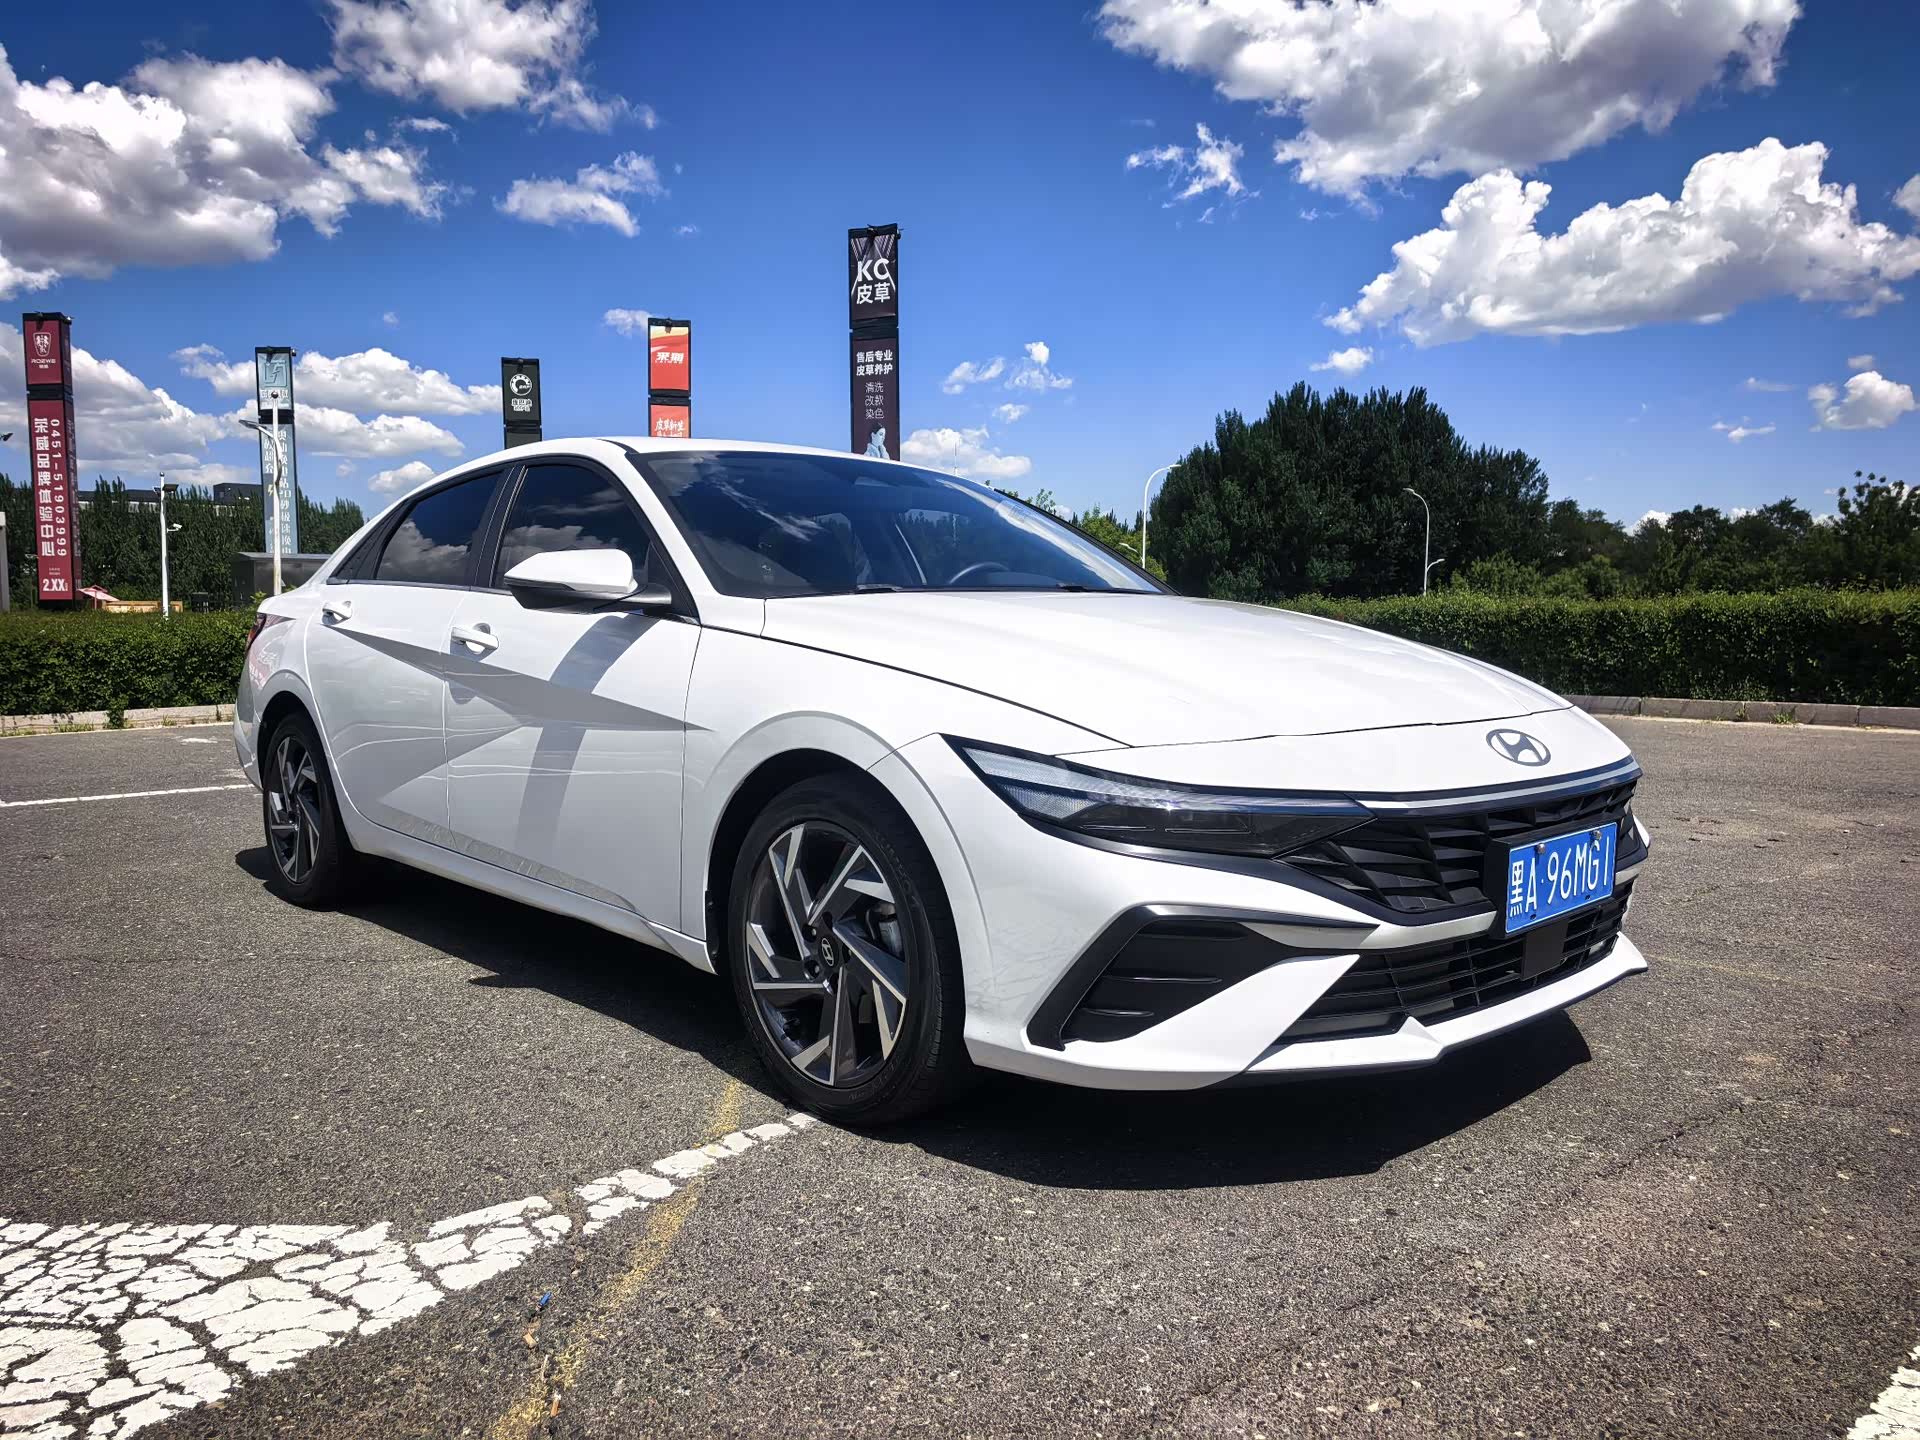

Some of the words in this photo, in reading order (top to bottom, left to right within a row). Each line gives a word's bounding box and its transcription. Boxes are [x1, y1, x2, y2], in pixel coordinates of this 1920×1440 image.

[857, 258, 889, 281] KC
[857, 282, 890, 304] 皮草
[856, 350, 893, 363] 售后专业
[856, 363, 893, 376] 皮草养护
[865, 382, 884, 393] 清洗
[865, 408, 884, 419] 染色
[34, 418, 55, 556] 荣威品牌体验中心
[50, 419, 67, 556] 0451-51903999
